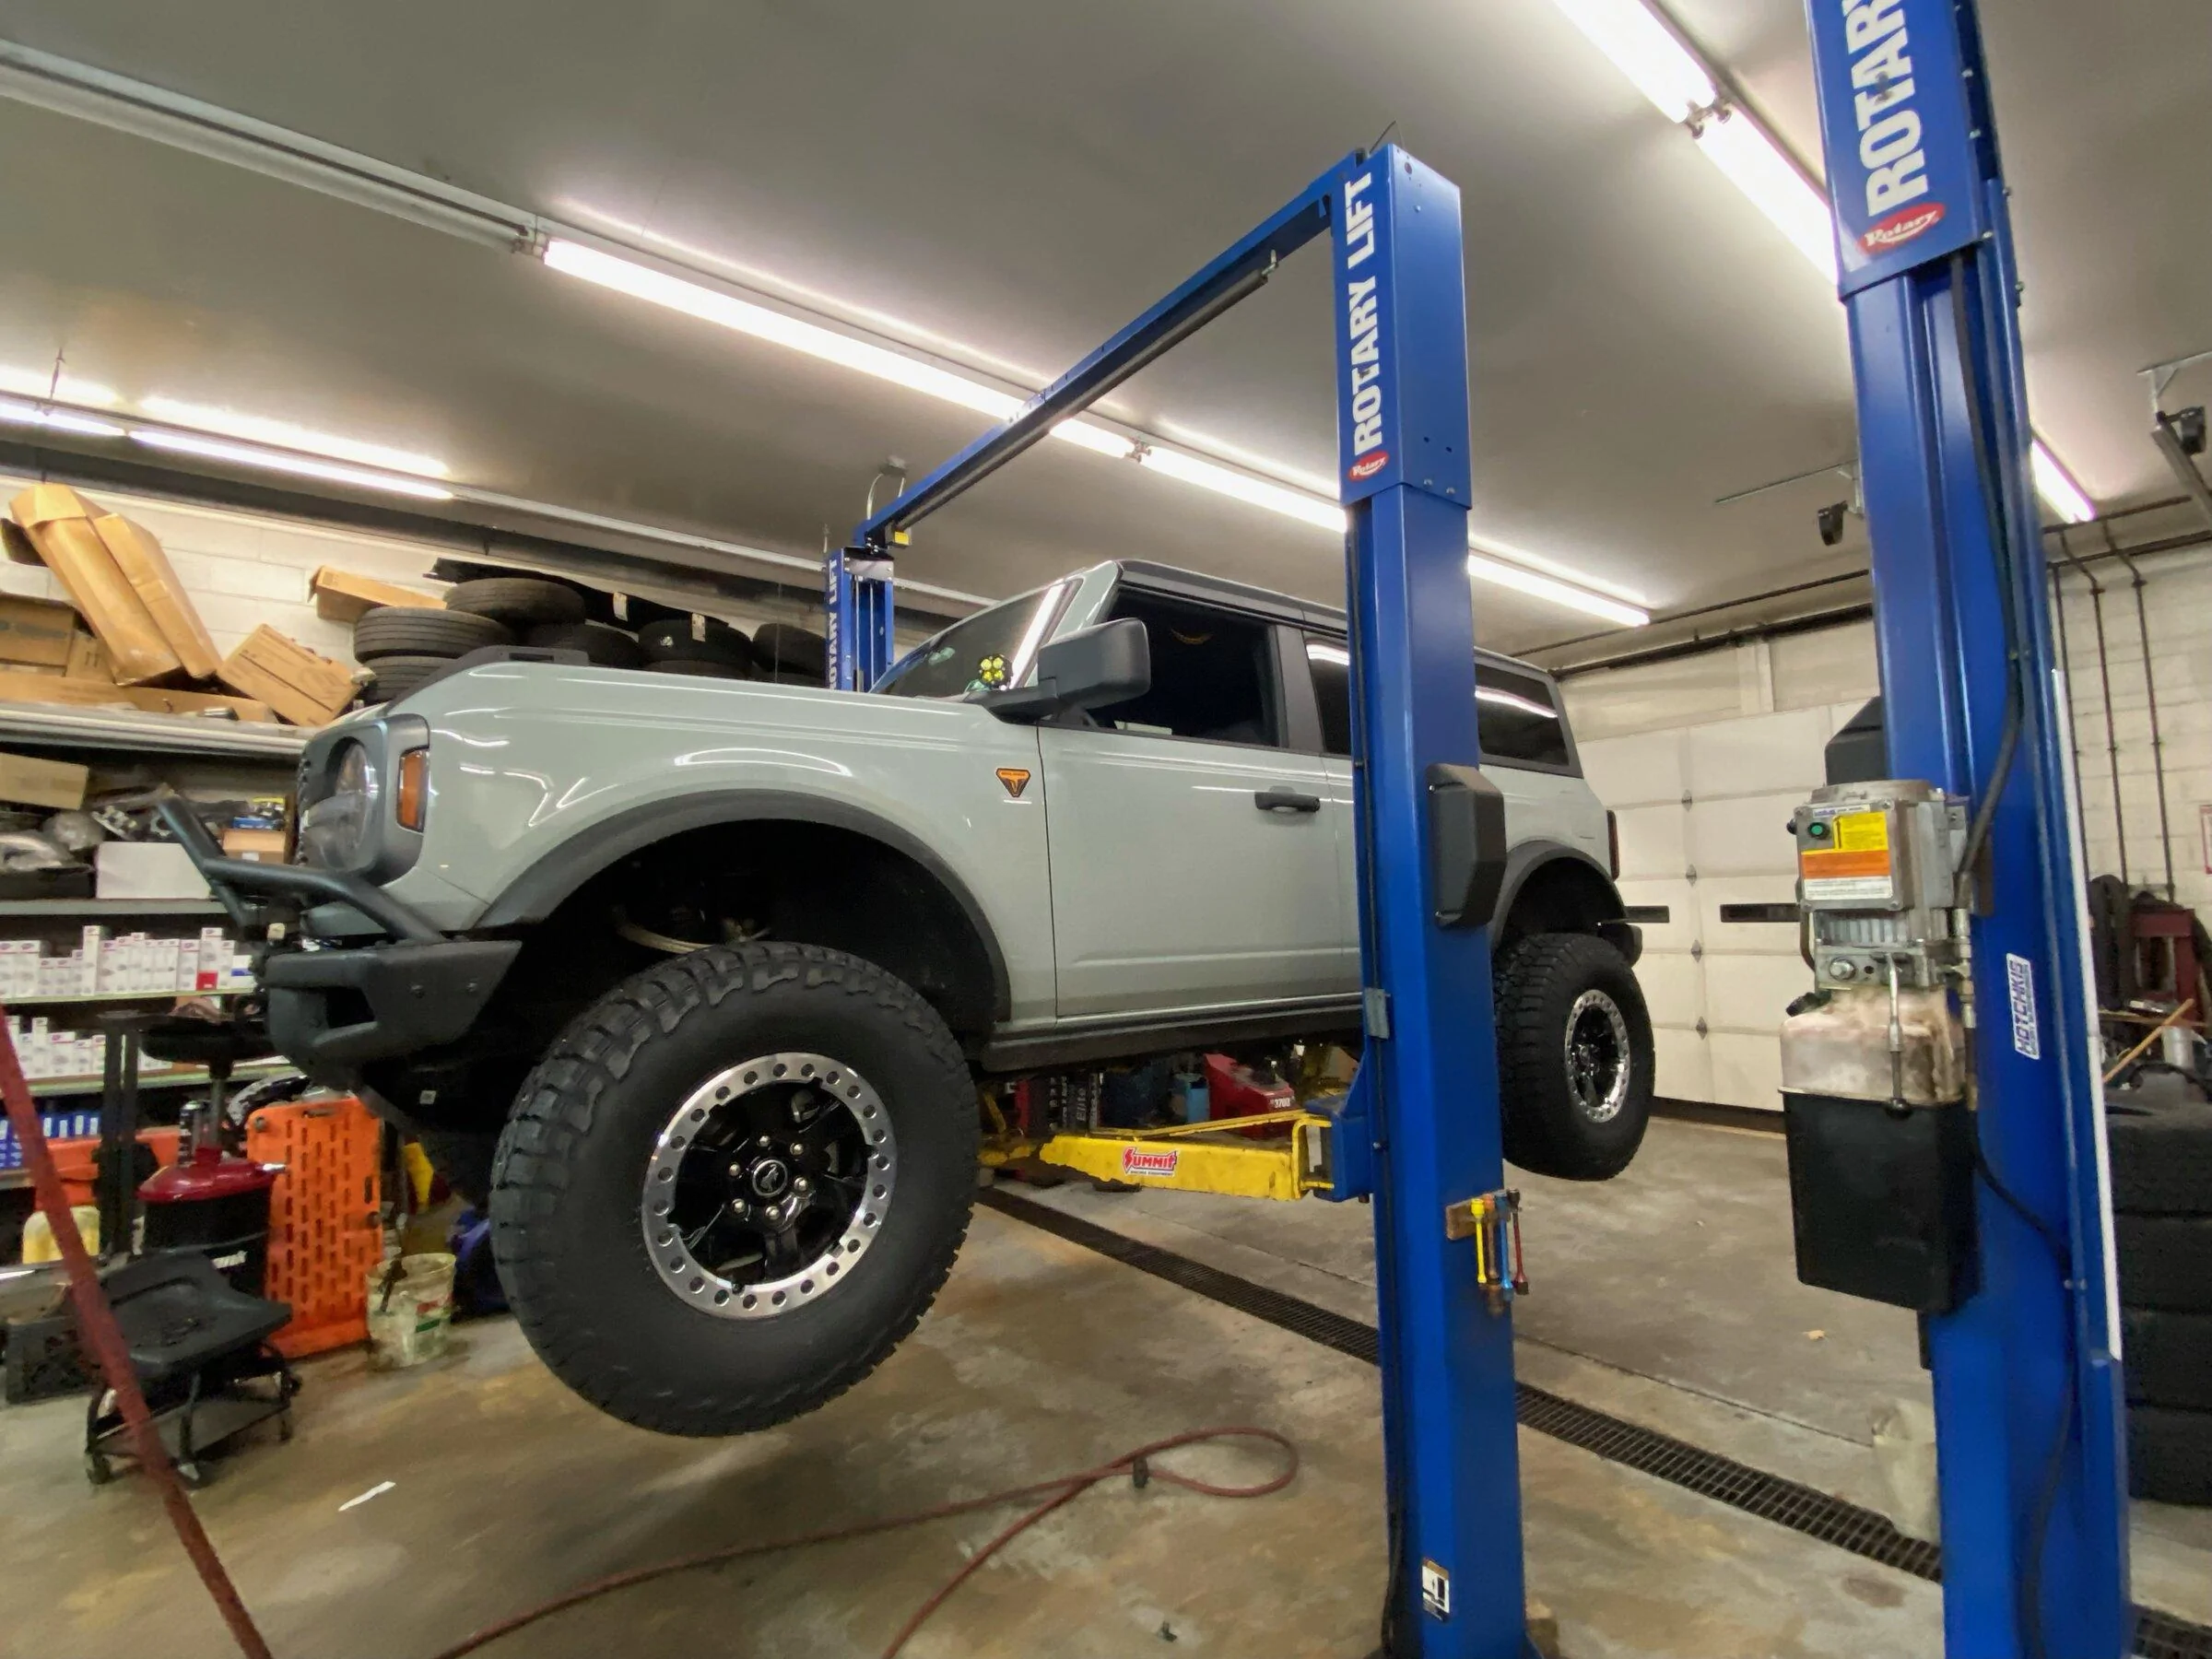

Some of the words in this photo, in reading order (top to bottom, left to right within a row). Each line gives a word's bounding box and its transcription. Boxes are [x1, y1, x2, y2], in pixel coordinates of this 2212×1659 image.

[1841, 0, 1929, 217] ROTAR
[1344, 171, 1376, 270] LIFT
[1864, 209, 1939, 246] Rotary
[1348, 276, 1382, 456] ROTARY
[1352, 457, 1385, 476] Rotary
[2009, 959, 2030, 1054] HOTCHKIS
